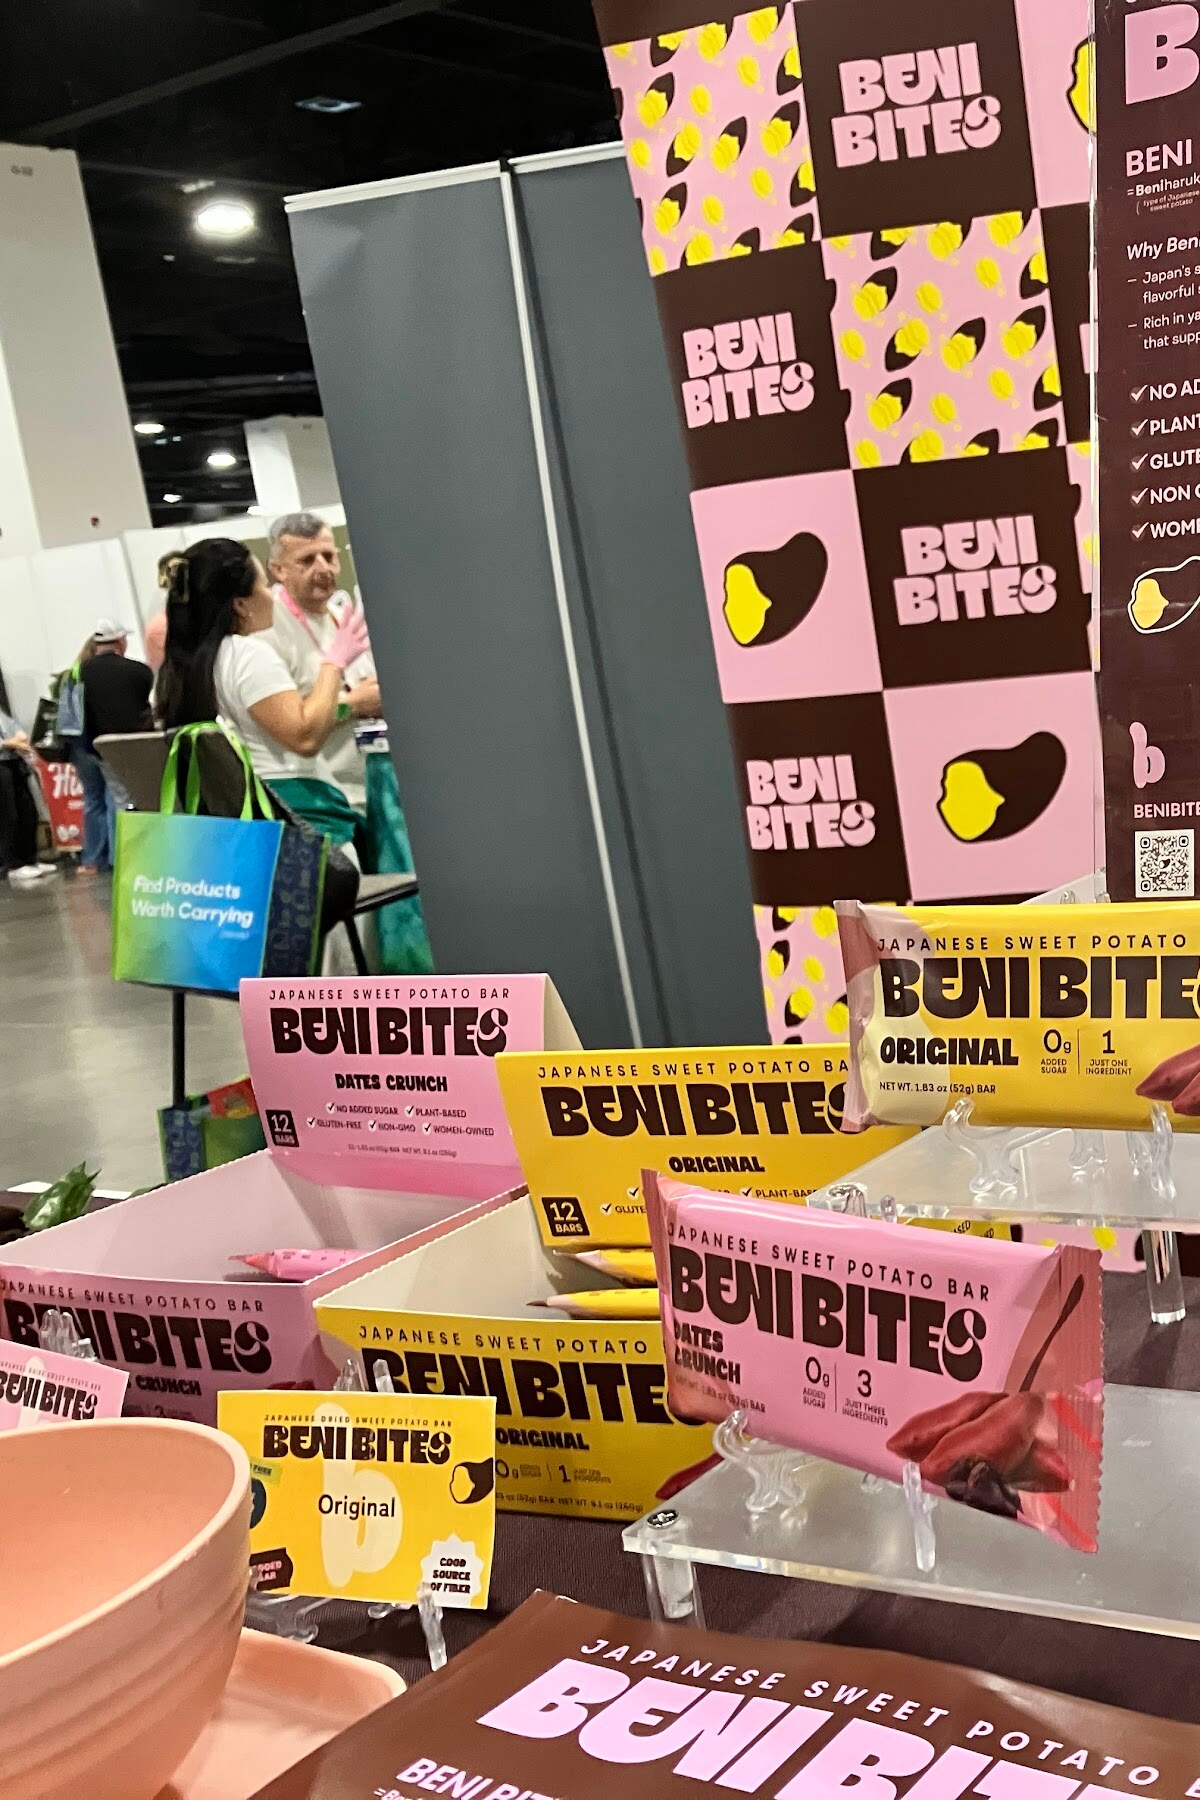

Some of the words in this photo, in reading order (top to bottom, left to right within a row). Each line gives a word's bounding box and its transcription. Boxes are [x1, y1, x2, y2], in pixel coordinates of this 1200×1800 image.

[839, 42, 982, 113] BENI
[831, 96, 1001, 167] BITES
[1126, 138, 1192, 177] BENI
[1127, 244, 1162, 260] Why
[1142, 266, 1192, 284] Japan's
[1143, 286, 1195, 304] flavorful
[1143, 313, 1170, 330] Rich
[1173, 310, 1185, 325] in
[683, 312, 796, 378] BENI
[1143, 334, 1170, 350] that
[682, 362, 814, 428] BITES
[1150, 382, 1177, 401] NO
[1150, 484, 1191, 505] NON
[166, 877, 241, 899] Products
[132, 899, 175, 918] Worth
[179, 902, 254, 928] Carrying
[878, 937, 988, 951] JAPANESE
[1005, 936, 1076, 950] SWEET
[1092, 934, 1186, 949] POTATO
[879, 957, 1029, 1018] BENI
[880, 1037, 1019, 1065] ORIGINAL
[1044, 1029, 1071, 1053] 0g
[1102, 1030, 1116, 1054] 1
[537, 1064, 639, 1079] JAPANESE
[653, 1062, 716, 1077] SWEET
[729, 1061, 811, 1075] POTATO
[1086, 1067, 1132, 1075] INGREDIENT
[1089, 1059, 1110, 1067] JUST
[335, 1074, 381, 1090] DATES
[386, 1075, 448, 1092] CRUNCH
[880, 1081, 895, 1091] NET
[897, 1082, 913, 1092] WT.
[915, 1083, 935, 1092] 1.83
[950, 1083, 974, 1094] (52g)
[977, 1084, 996, 1093] BAR
[541, 1083, 688, 1138] BENI
[669, 1156, 765, 1173] ORIGINAL
[550, 1202, 579, 1221] 12
[555, 1223, 583, 1234] BARS
[668, 1222, 758, 1256] JAPANESE
[772, 1244, 835, 1271] SWEET
[848, 1259, 932, 1289] POTATO
[948, 1278, 989, 1302] BAR
[669, 1243, 794, 1339] BENI
[801, 1273, 987, 1382] BITES
[113, 1311, 272, 1374] BITES
[806, 1356, 830, 1387] 0g
[857, 1369, 872, 1398] 3
[135, 1374, 203, 1396] CRUNCH
[39, 1380, 98, 1420] BITES
[263, 1425, 347, 1459] BENI
[352, 1427, 452, 1464] BITES
[496, 1427, 590, 1450] ORIGINAL
[318, 1494, 395, 1520] Original
[432, 1569, 471, 1581] SOURCE
[580, 1639, 786, 1690] JAPANESE
[803, 1680, 949, 1728] SWEET
[965, 1720, 1161, 1787] POTATO
[476, 1658, 834, 1794] BENI
